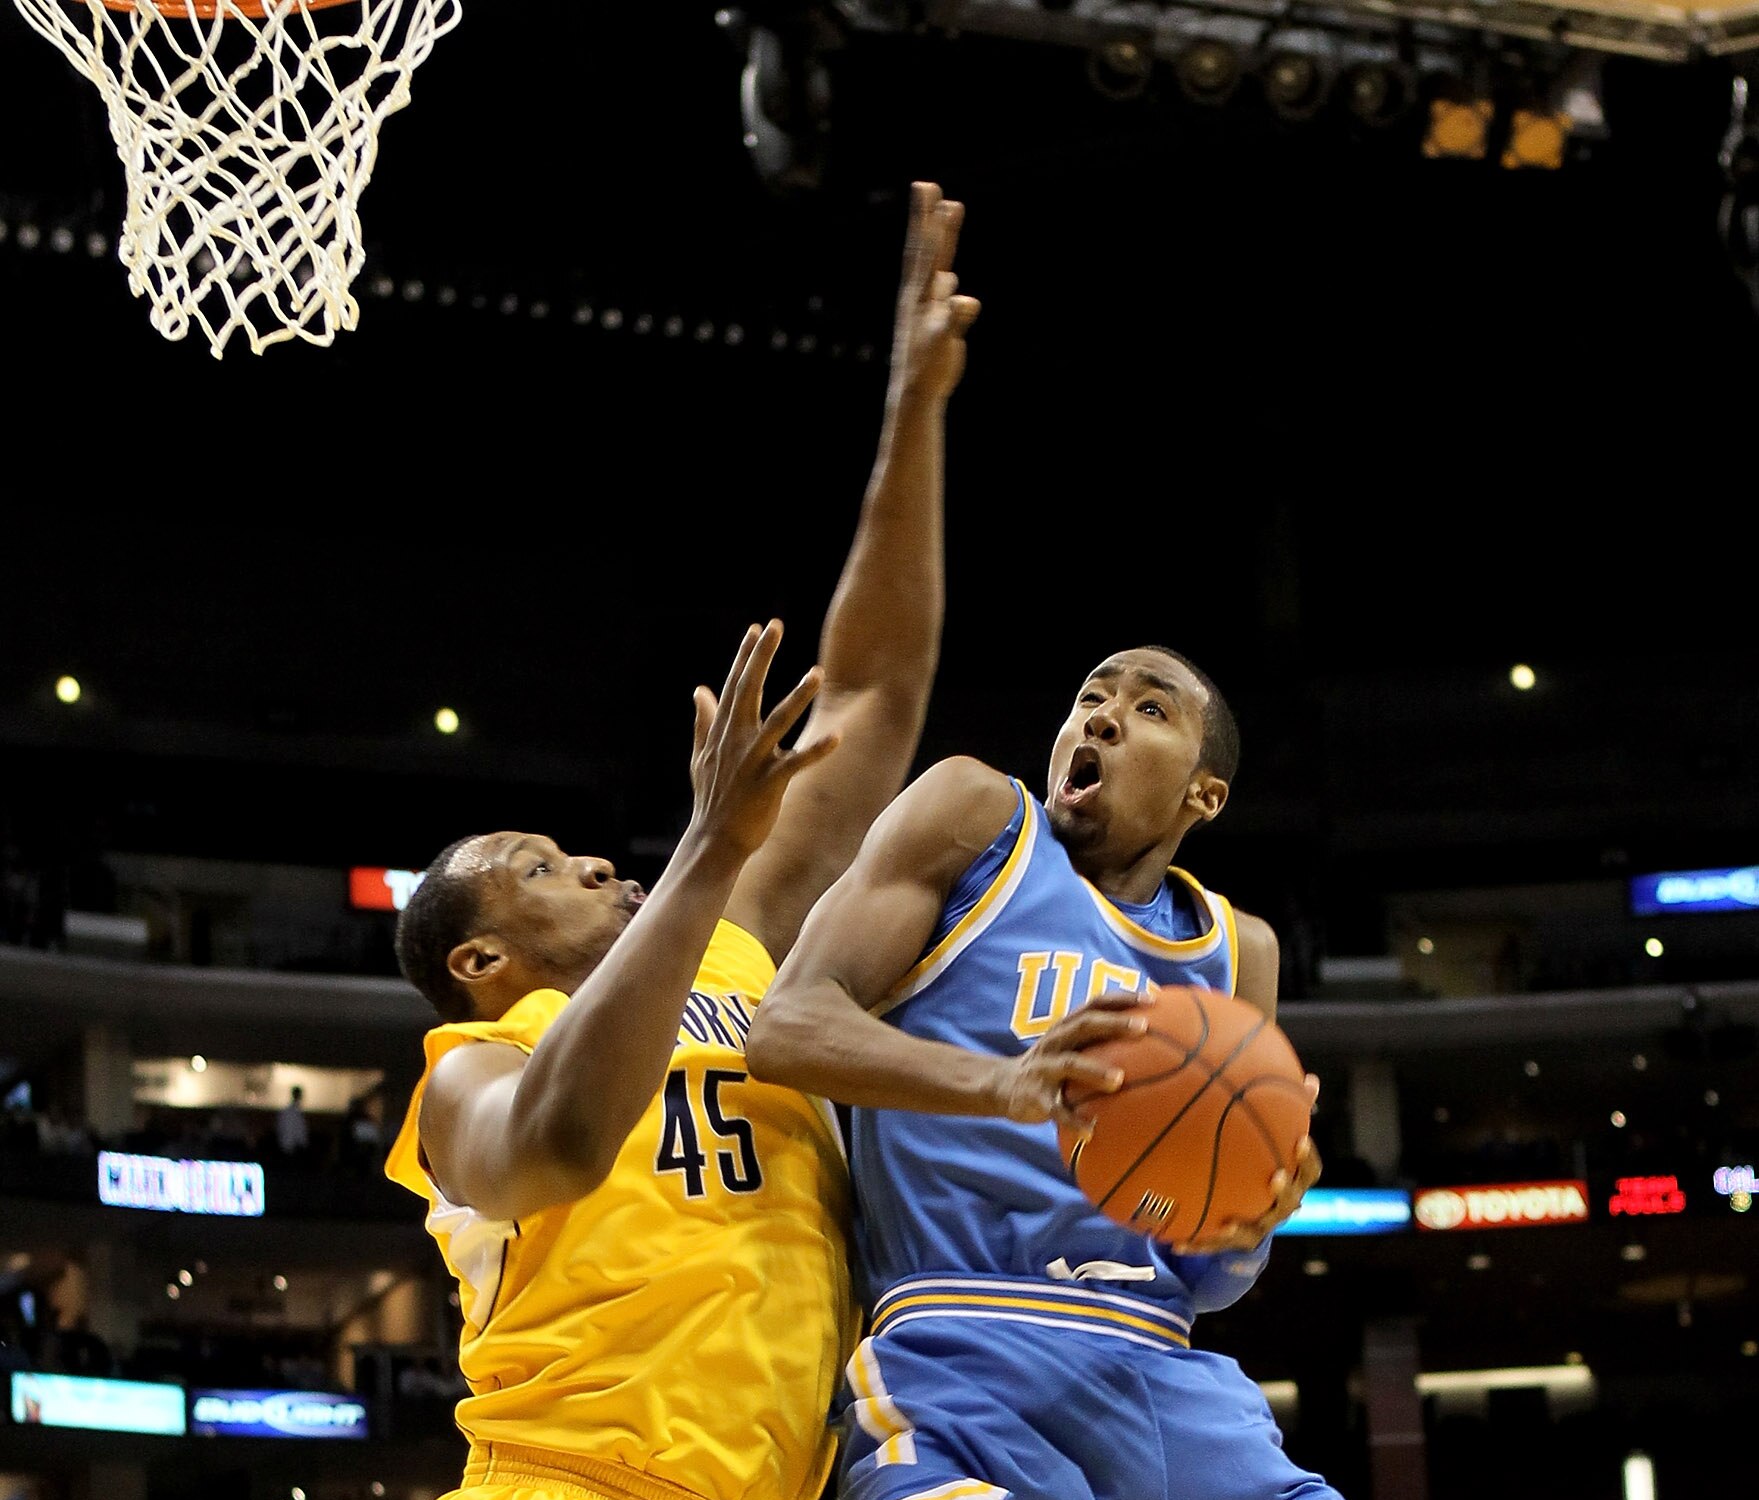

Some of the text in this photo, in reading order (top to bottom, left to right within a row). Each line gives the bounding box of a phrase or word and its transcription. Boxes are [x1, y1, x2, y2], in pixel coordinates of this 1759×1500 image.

[675, 987, 757, 1055] ORN
[1010, 950, 1161, 1040] UC
[655, 1069, 764, 1198] 45
[1464, 1185, 1588, 1223] TOYOTA
